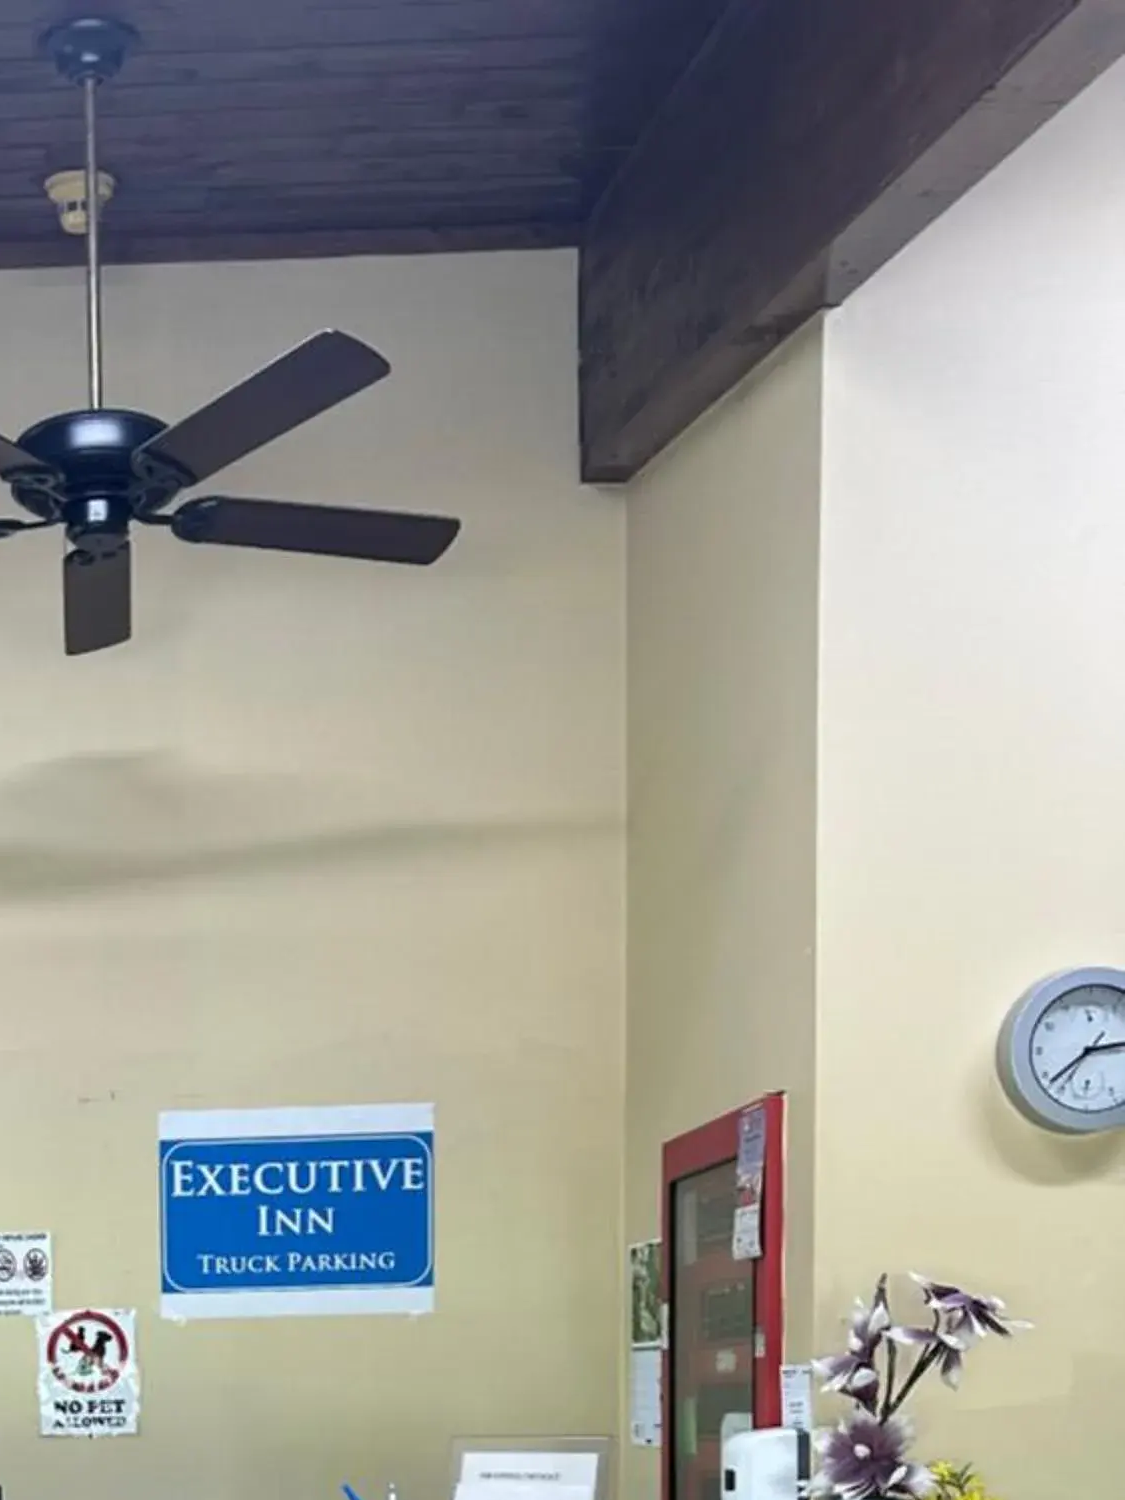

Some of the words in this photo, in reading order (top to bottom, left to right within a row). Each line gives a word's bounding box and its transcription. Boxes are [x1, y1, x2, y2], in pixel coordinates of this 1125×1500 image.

[169, 1157, 425, 1199] EXECUTIVE
[257, 1204, 336, 1237] INN
[196, 1253, 281, 1275] TRUCK
[286, 1251, 396, 1273] PARKING
[53, 1399, 83, 1415] NO
[87, 1399, 126, 1414] PET
